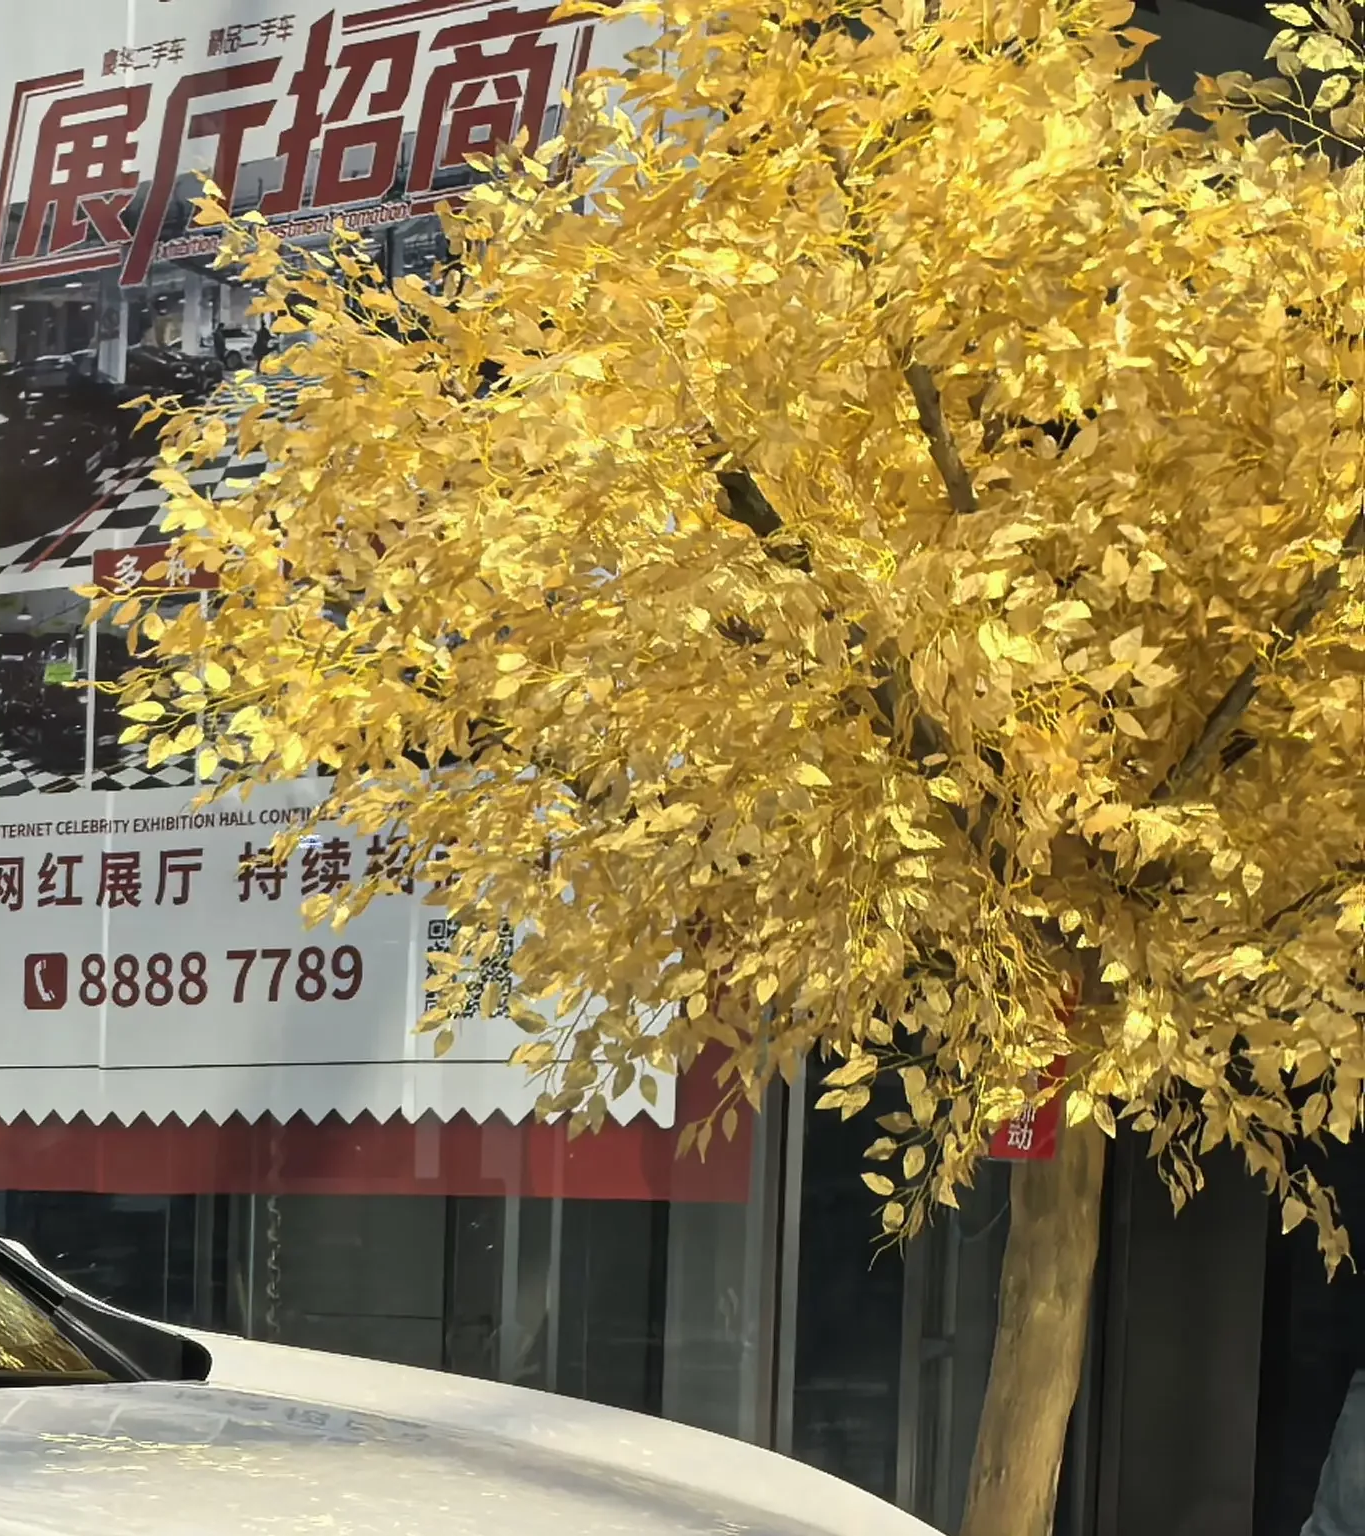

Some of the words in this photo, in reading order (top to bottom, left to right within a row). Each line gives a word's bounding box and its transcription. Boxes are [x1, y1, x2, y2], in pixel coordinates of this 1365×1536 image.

[16, 4, 563, 286] 展厅招商
[55, 818, 131, 836] CELEBRITY
[133, 812, 215, 833] EXHIBITION
[219, 809, 256, 827] HALL
[79, 951, 208, 1008] 8888
[226, 944, 364, 1004] 7789
